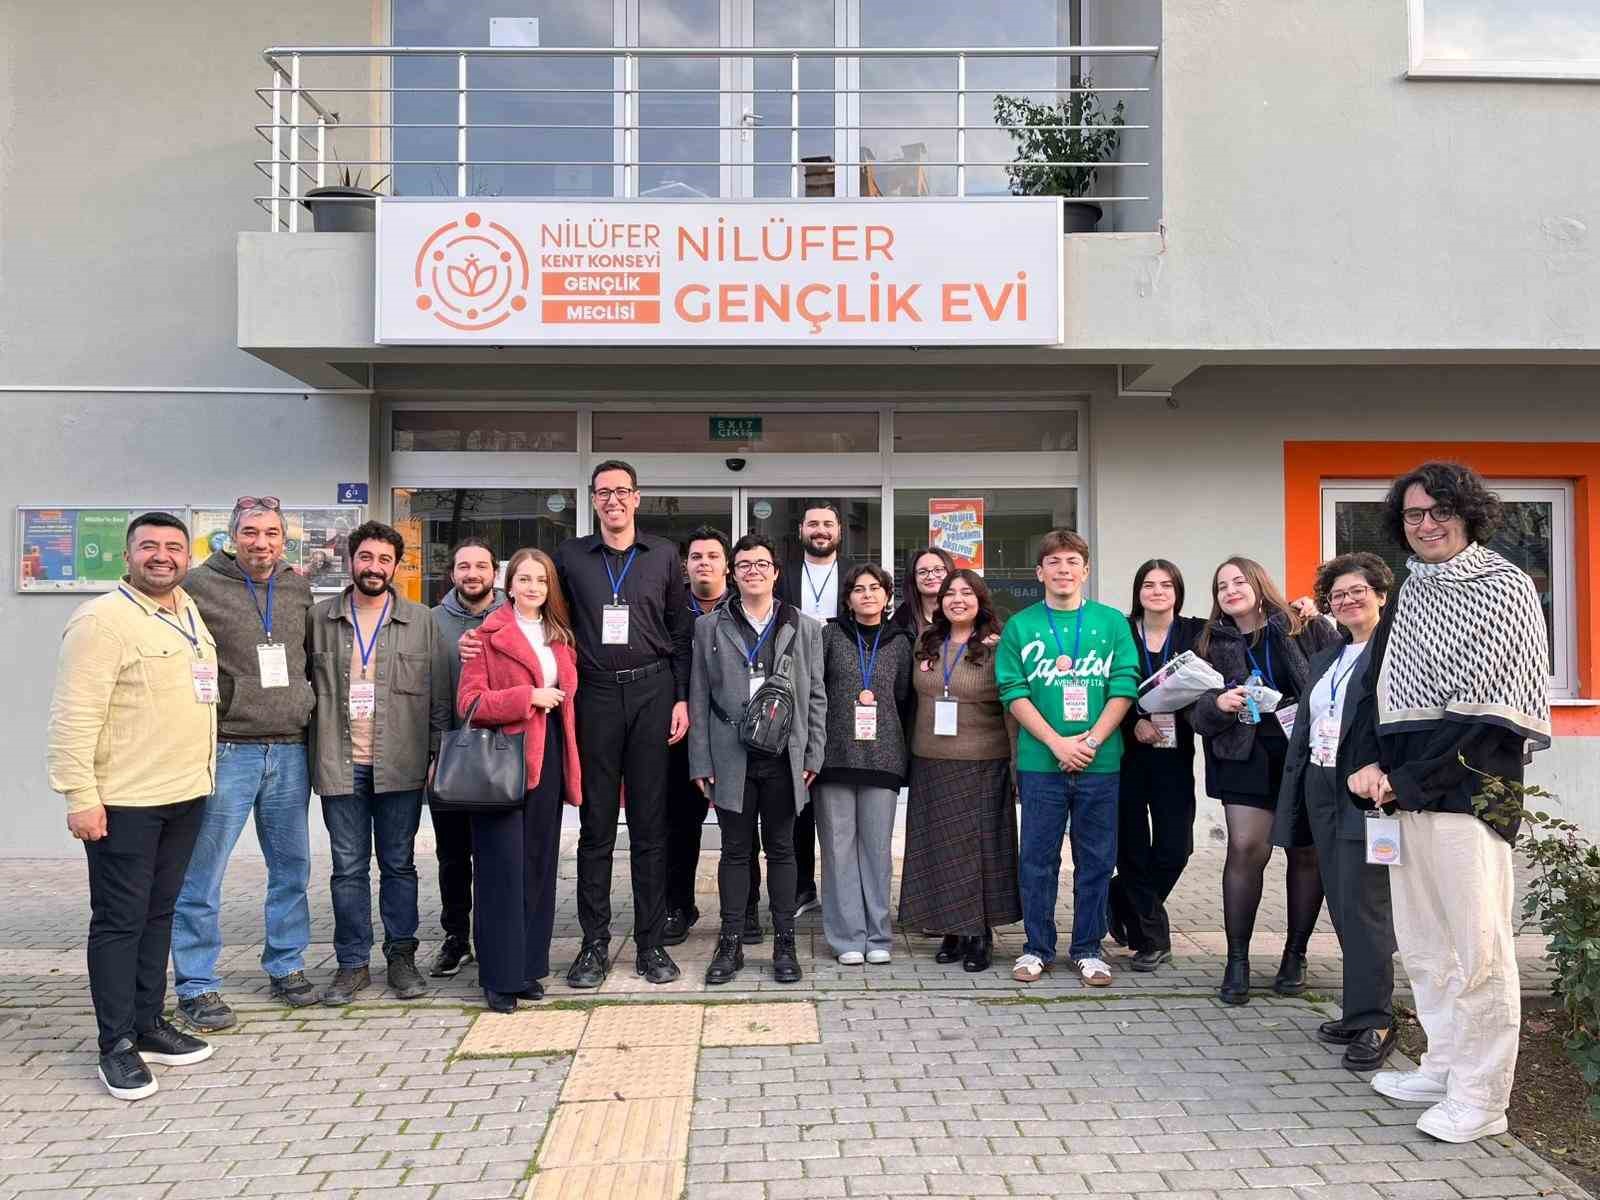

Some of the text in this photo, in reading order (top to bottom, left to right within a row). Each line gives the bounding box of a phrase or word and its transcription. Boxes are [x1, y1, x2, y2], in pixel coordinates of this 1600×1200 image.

[541, 217, 661, 248] NİLÜFER
[677, 217, 895, 262] NİLÜFER
[541, 251, 661, 268] KENT KONSEYİ
[564, 273, 641, 295] GENÇLİK
[566, 302, 636, 321] MECLİSİ
[674, 271, 1028, 335] GENÇLİK EVİ
[718, 420, 753, 429] EXIT
